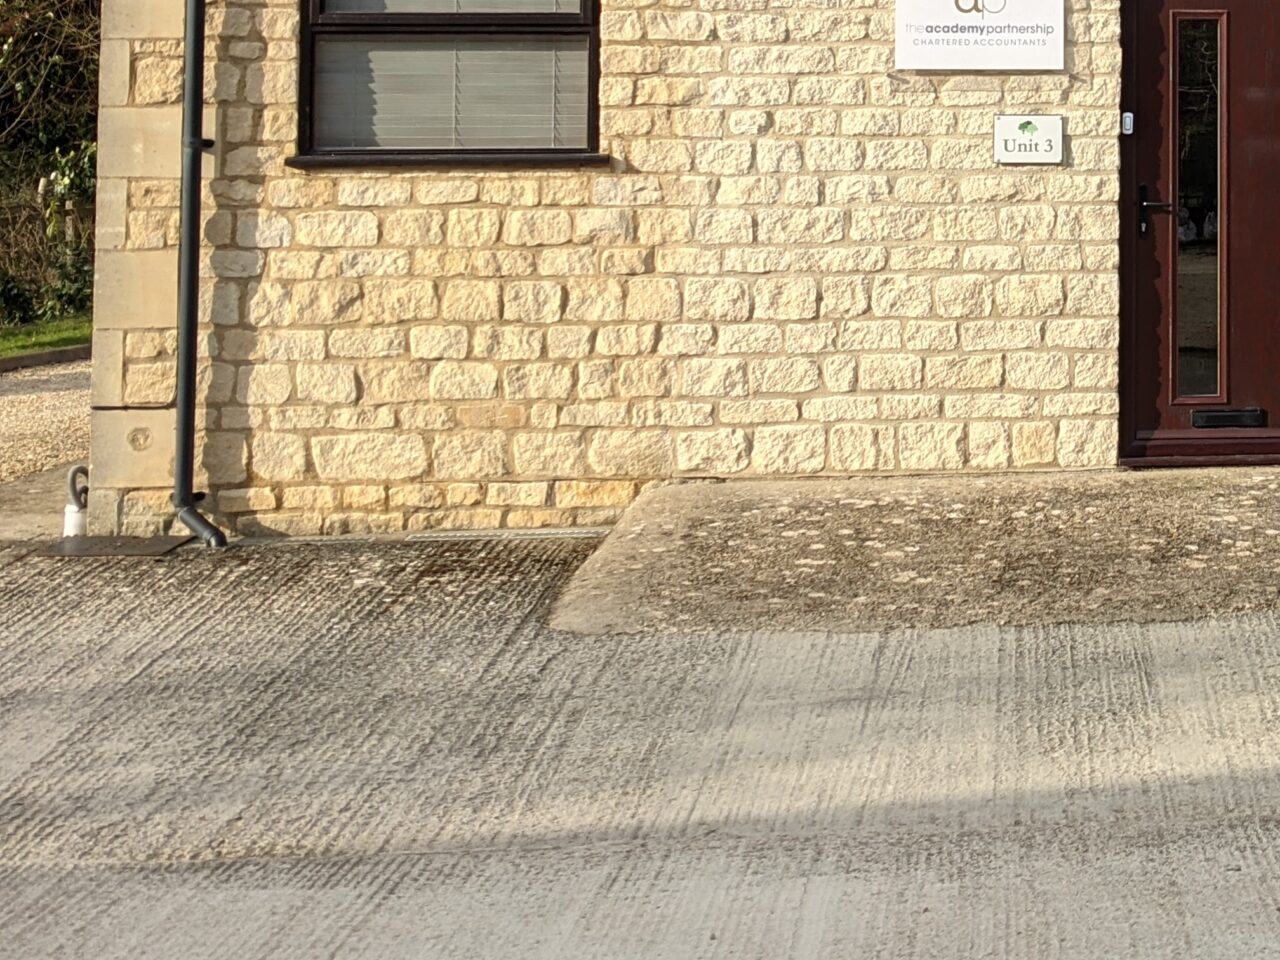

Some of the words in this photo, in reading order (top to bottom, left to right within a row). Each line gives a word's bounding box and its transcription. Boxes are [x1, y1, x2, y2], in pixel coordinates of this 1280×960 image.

[912, 38, 971, 46] CHARTERED
[973, 38, 1047, 46] ACCOUNTANTS
[1003, 138, 1040, 153] Unit
[1044, 138, 1053, 153] 3
